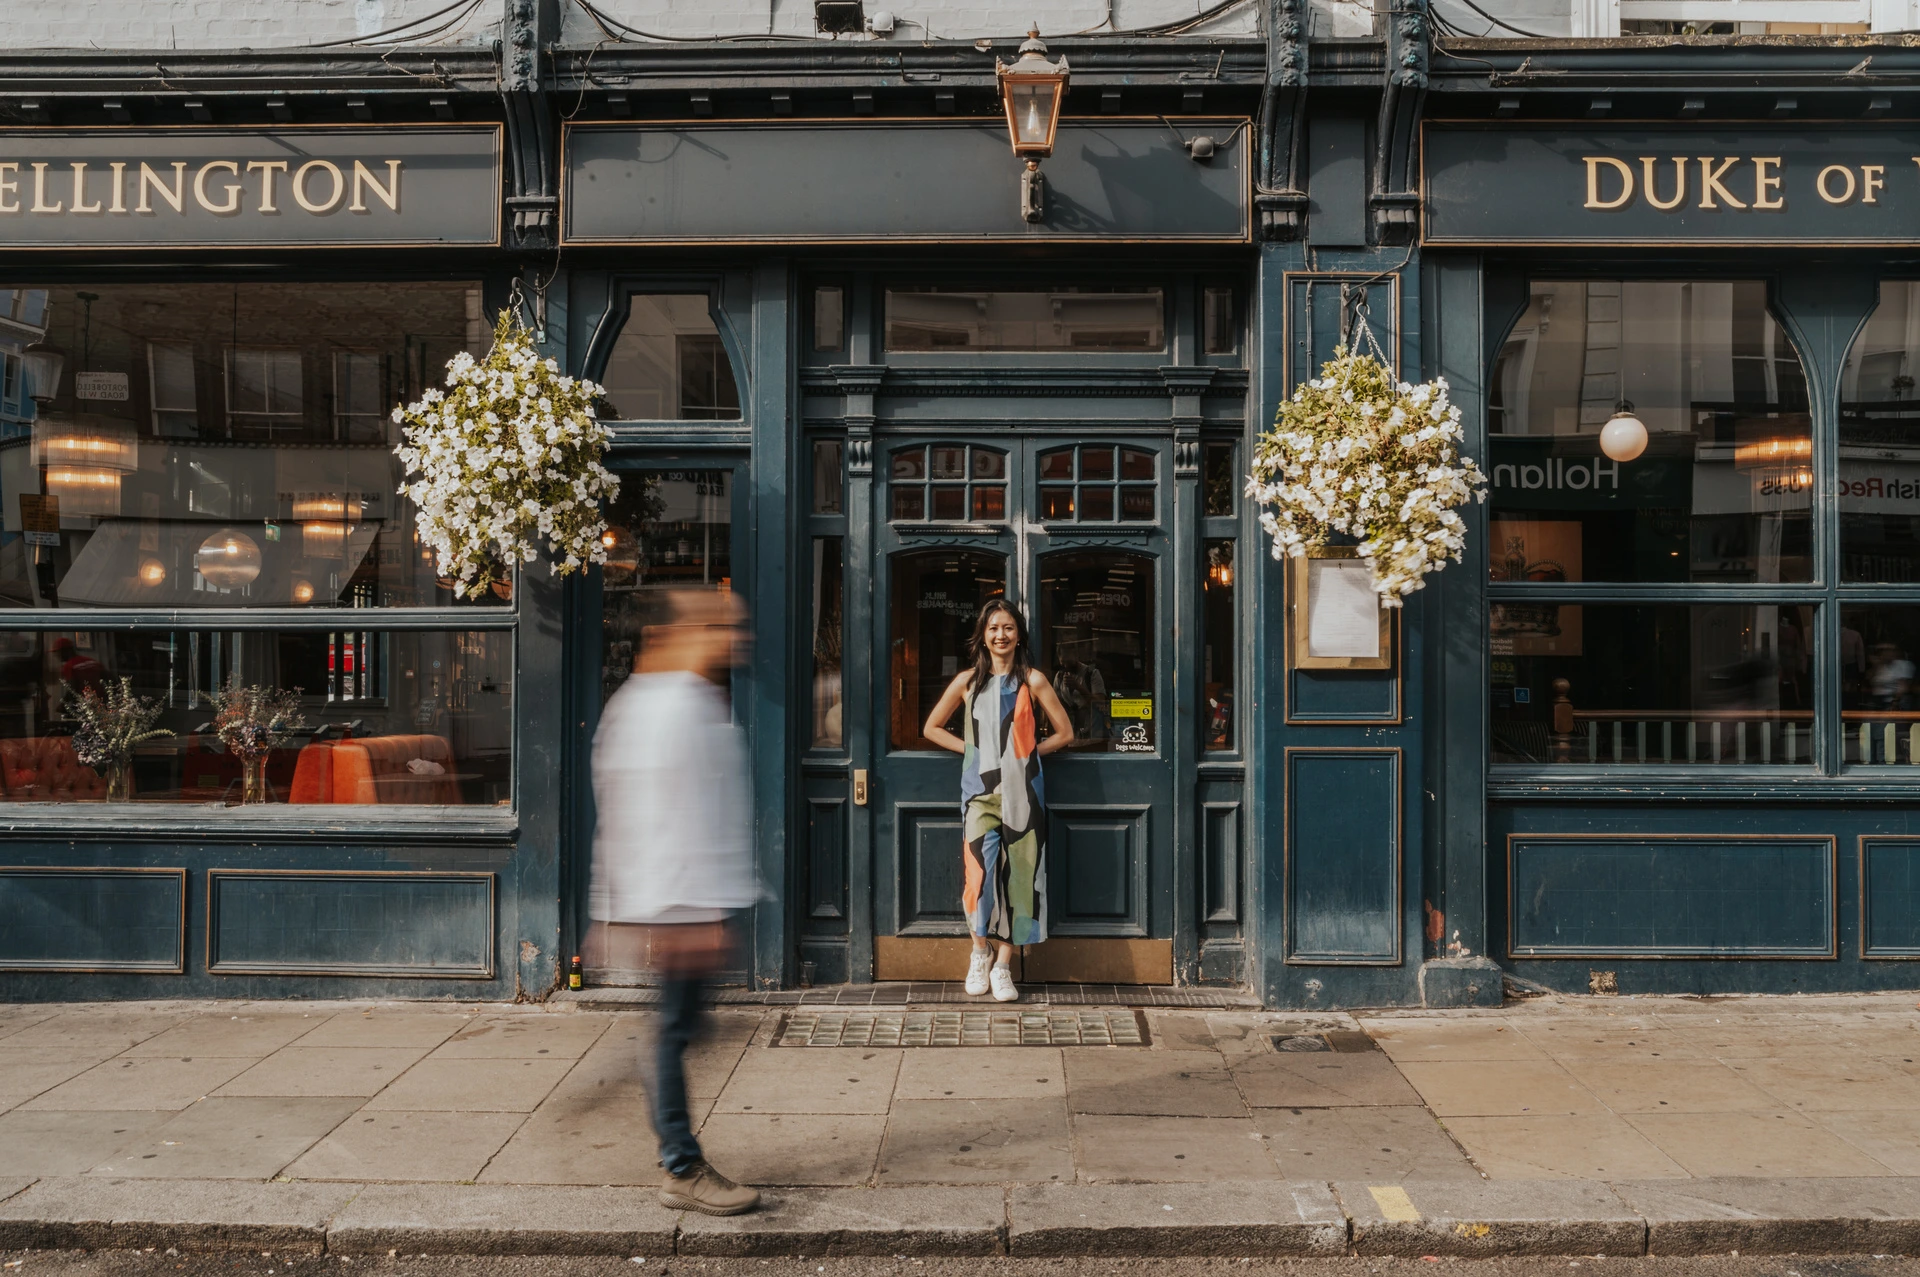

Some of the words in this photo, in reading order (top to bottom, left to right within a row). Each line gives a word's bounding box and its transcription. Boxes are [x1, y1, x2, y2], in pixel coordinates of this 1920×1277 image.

[0, 159, 402, 214] ELLINGTON
[1582, 156, 1785, 210] DUKE
[1816, 164, 1885, 204] OF
